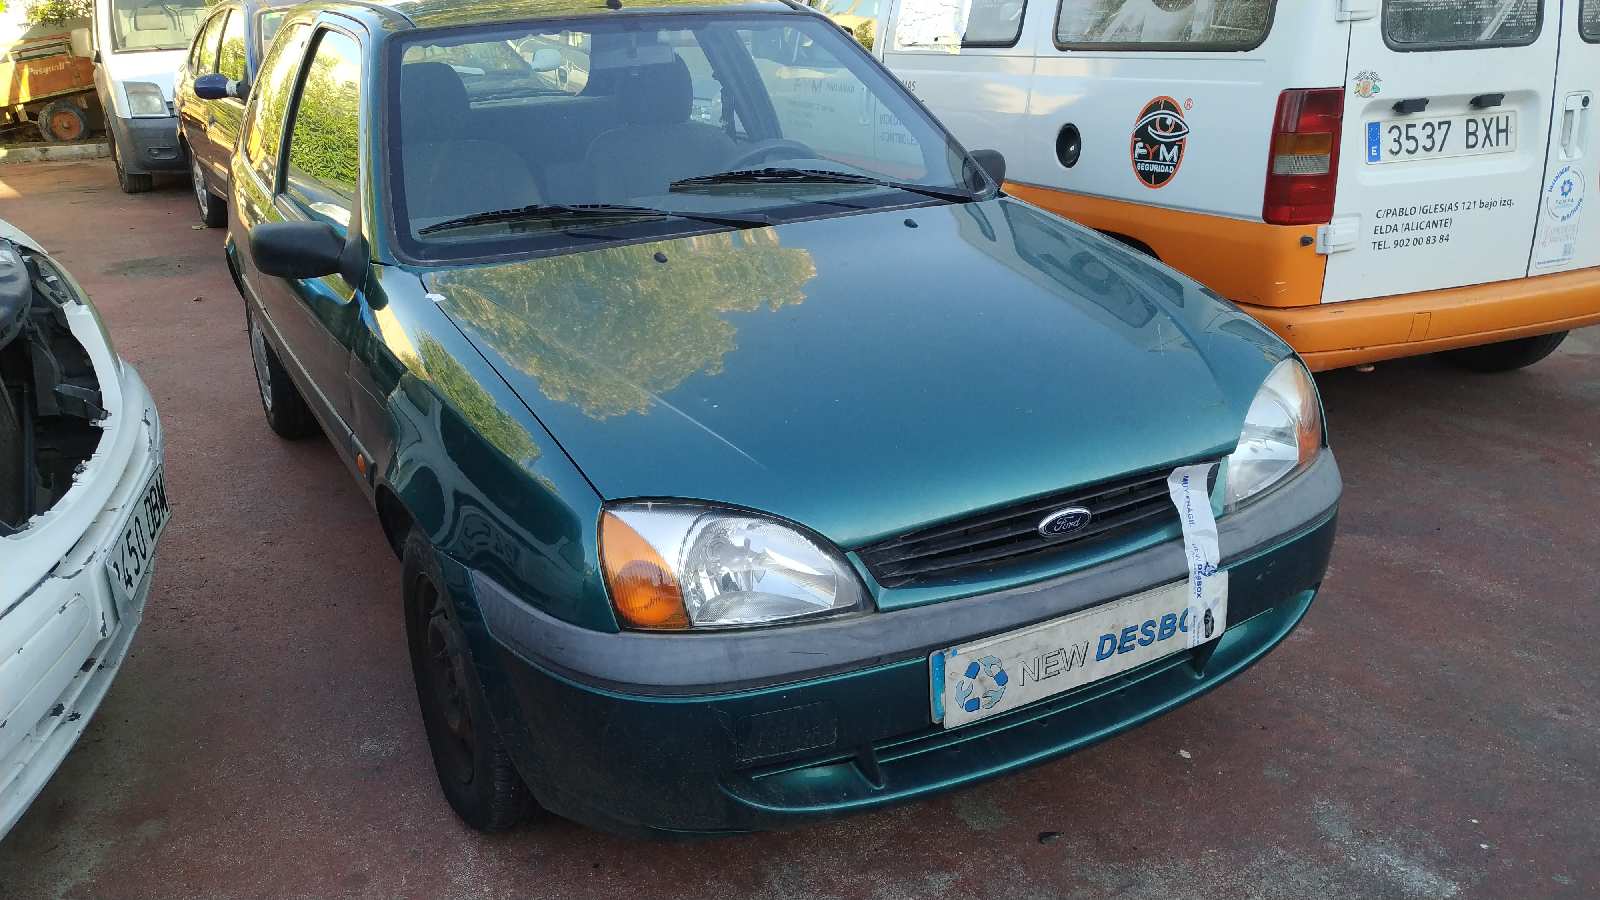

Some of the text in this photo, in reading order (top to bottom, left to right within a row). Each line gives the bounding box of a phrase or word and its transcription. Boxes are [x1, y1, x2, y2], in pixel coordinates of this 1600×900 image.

[1388, 115, 1510, 156] 3537 BXH
[1135, 142, 1180, 162] FYM
[1371, 146, 1378, 156] E
[1136, 163, 1175, 173] SEGURIDAD
[1375, 197, 1515, 219] C/PABLO IGLESIAS 121 bajo izq.
[1373, 218, 1453, 235] ELDA (ALICANTE)
[1371, 233, 1450, 251] TEL. 902 00 83 84
[1018, 640, 1090, 687] NEW
